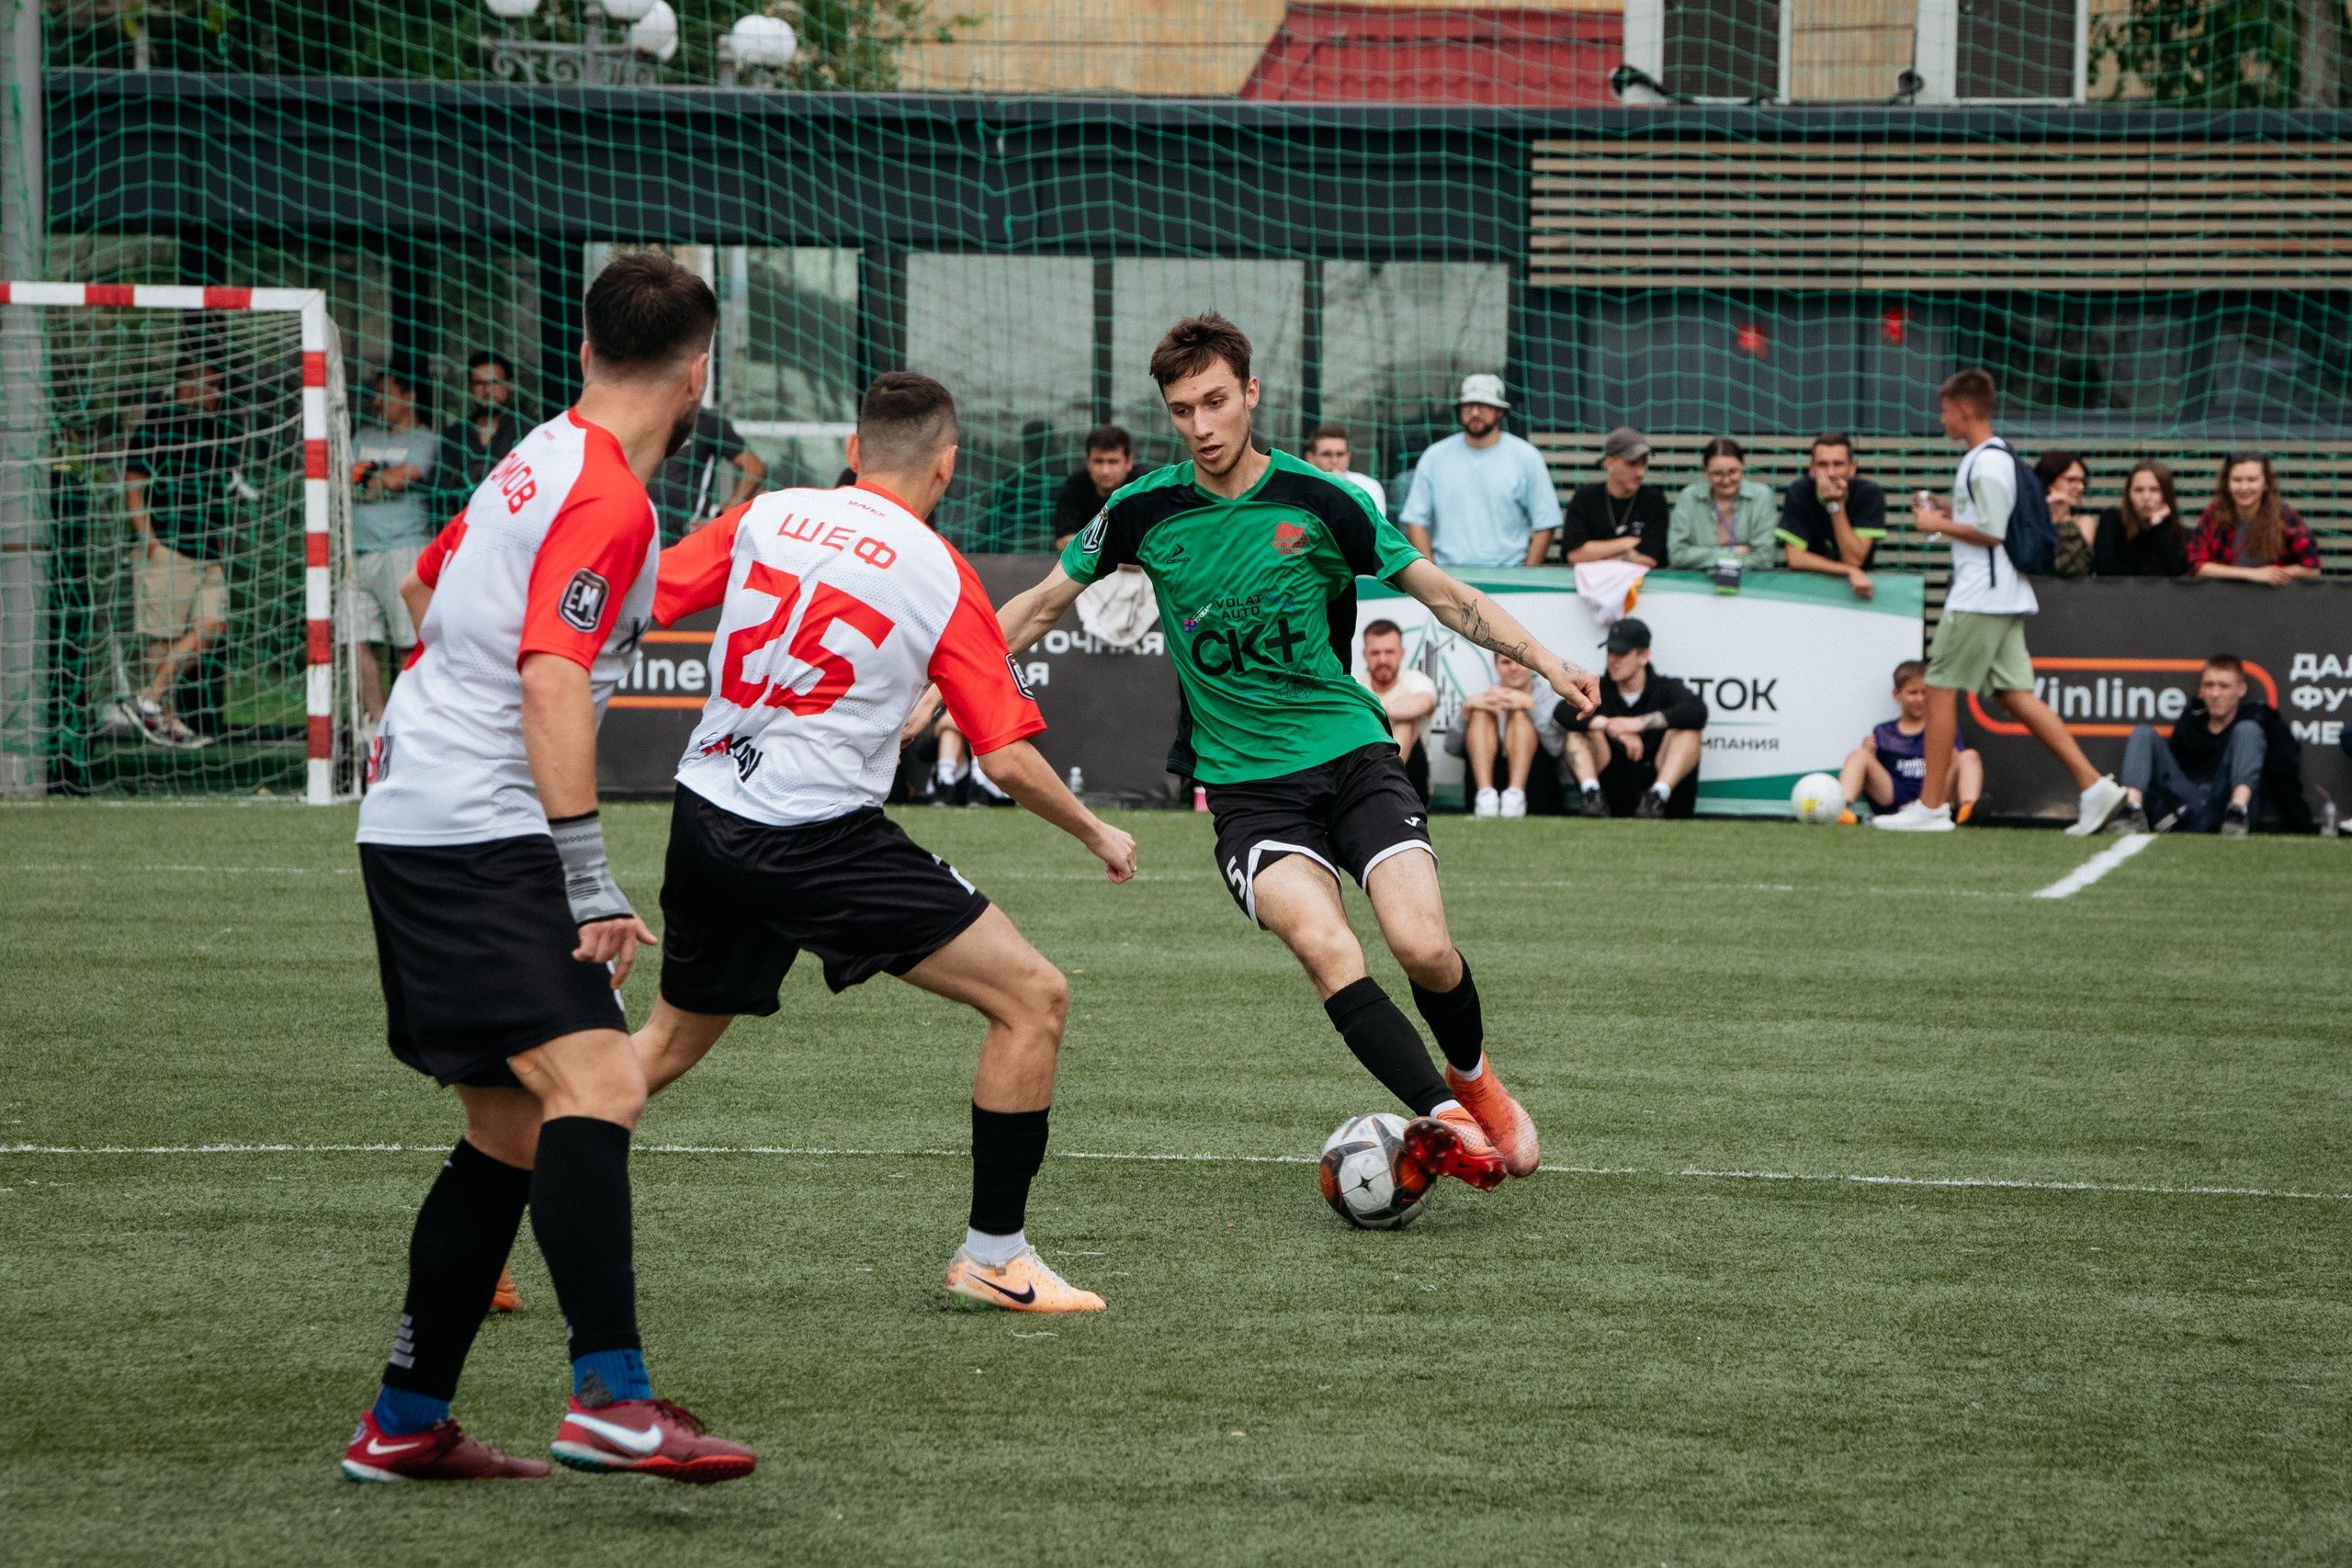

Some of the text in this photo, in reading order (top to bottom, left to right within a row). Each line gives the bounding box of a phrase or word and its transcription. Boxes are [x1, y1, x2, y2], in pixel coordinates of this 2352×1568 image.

[777, 513, 897, 570] ШЕФ
[1215, 593, 1262, 608] VOLAT
[1221, 605, 1261, 620] AUTO
[720, 559, 897, 717] 25
[616, 649, 706, 691] ine
[1690, 678, 1777, 711] ТОК
[2290, 684, 2352, 712] ФУ
